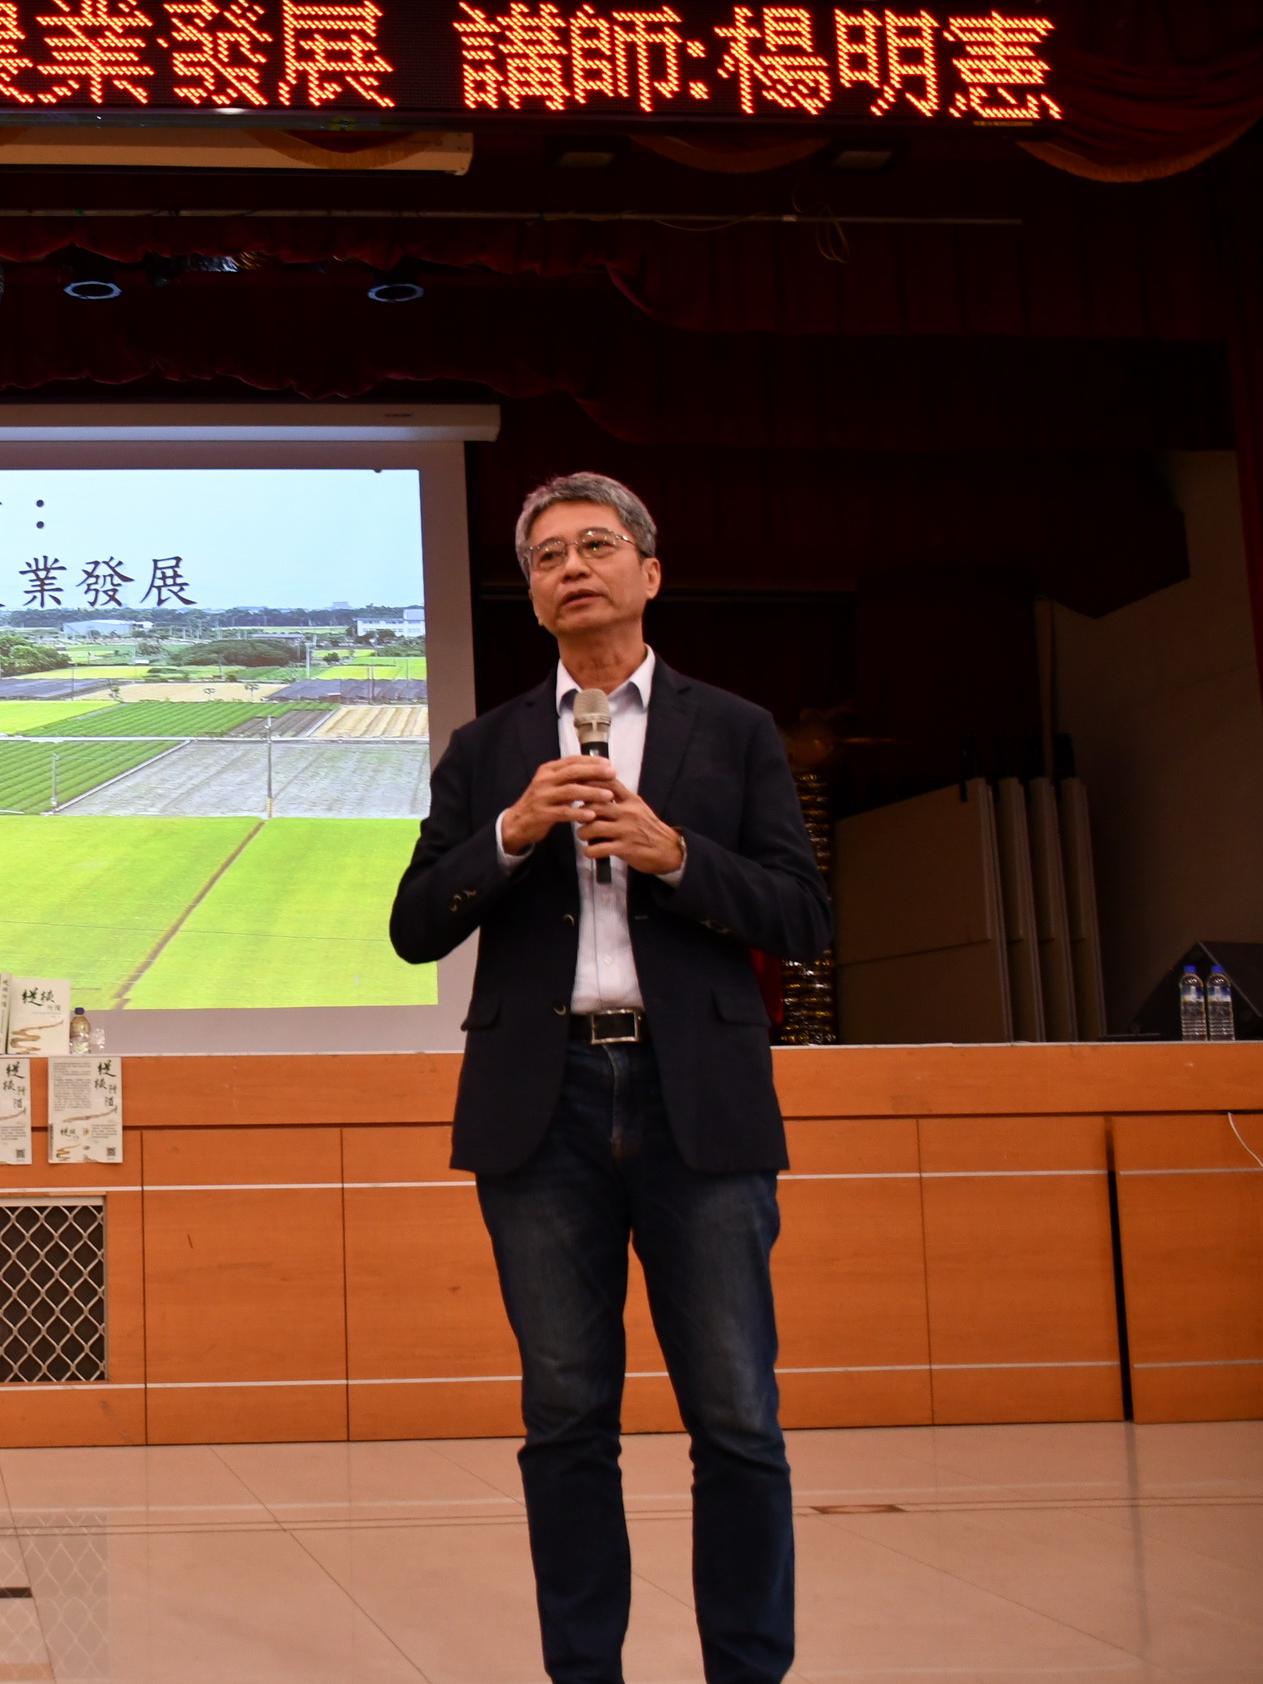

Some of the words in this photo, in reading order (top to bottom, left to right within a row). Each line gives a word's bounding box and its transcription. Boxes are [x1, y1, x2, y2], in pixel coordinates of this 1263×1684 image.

[452, 1, 1064, 121] 講師:楊明憲
